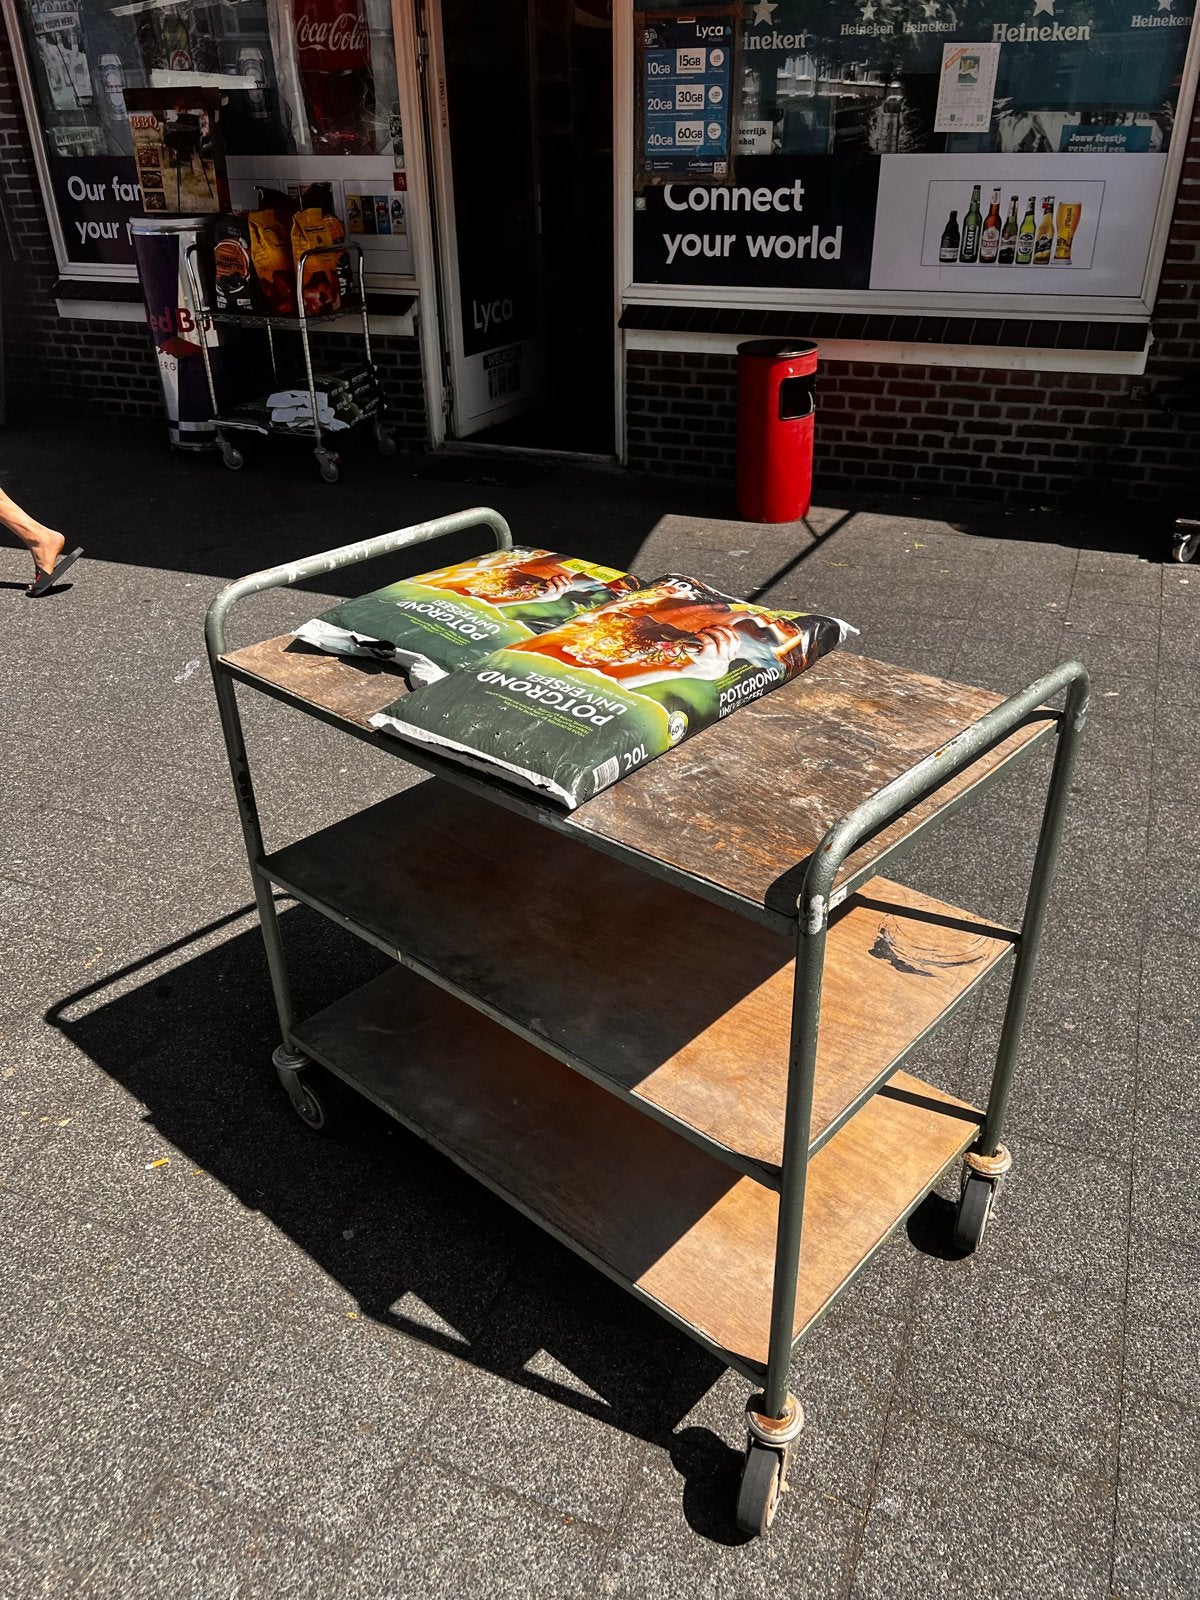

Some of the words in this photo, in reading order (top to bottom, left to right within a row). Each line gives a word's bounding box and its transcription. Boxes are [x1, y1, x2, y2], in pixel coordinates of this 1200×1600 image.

[696, 24, 724, 39] Lyca
[840, 23, 895, 36] Heineken
[902, 20, 957, 34] Heineken
[1131, 14, 1193, 28] Heineken
[743, 31, 806, 51] ineken
[991, 21, 1091, 43] Heineken
[647, 62, 671, 75] 10GB
[679, 55, 701, 66] 15GB
[647, 98, 673, 111] 20GB
[678, 91, 703, 103] 30GB
[647, 134, 674, 146] 40GB
[677, 127, 703, 139] 60GB
[1069, 133, 1094, 142] Jouw
[1095, 133, 1127, 144] feestje
[67, 175, 106, 201] Our
[663, 179, 805, 212] Connect
[75, 221, 119, 244] your
[662, 233, 736, 264] your
[746, 225, 843, 260] world
[150, 306, 174, 334] ed
[473, 298, 515, 334] Lyca
[396, 601, 489, 641] POTGROND
[525, 671, 628, 716] UNIVERSEEL
[719, 666, 780, 707] POTGROND
[476, 670, 615, 726] POTGROND
[623, 743, 649, 771] 20L
